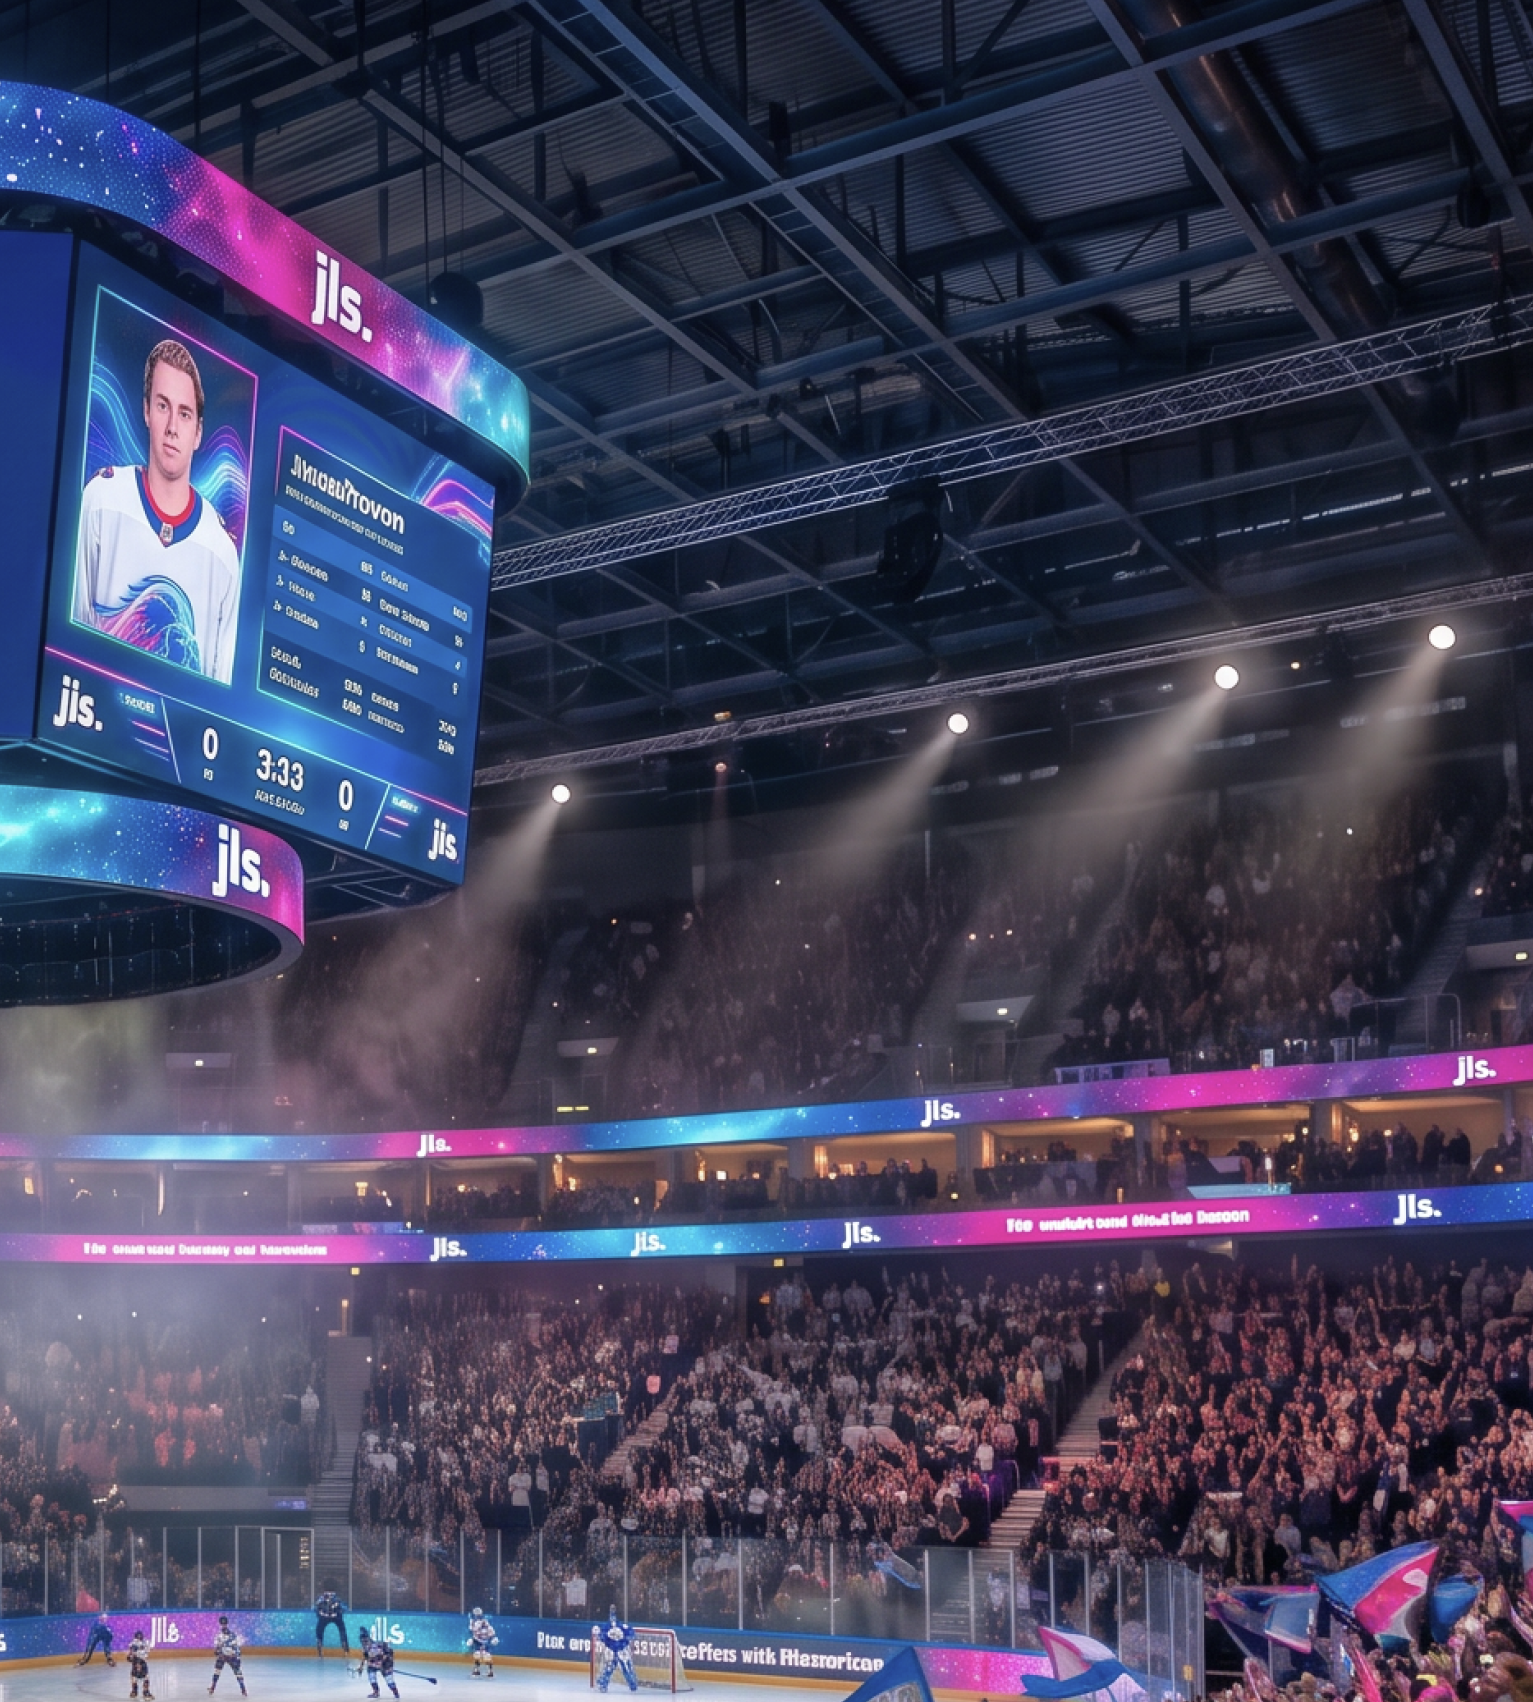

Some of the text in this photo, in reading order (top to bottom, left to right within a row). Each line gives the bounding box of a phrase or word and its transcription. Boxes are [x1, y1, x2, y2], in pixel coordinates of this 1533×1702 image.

[311, 250, 372, 342] jls.
[202, 726, 220, 760] 0
[338, 779, 354, 811] 0
[211, 823, 271, 898] jls.
